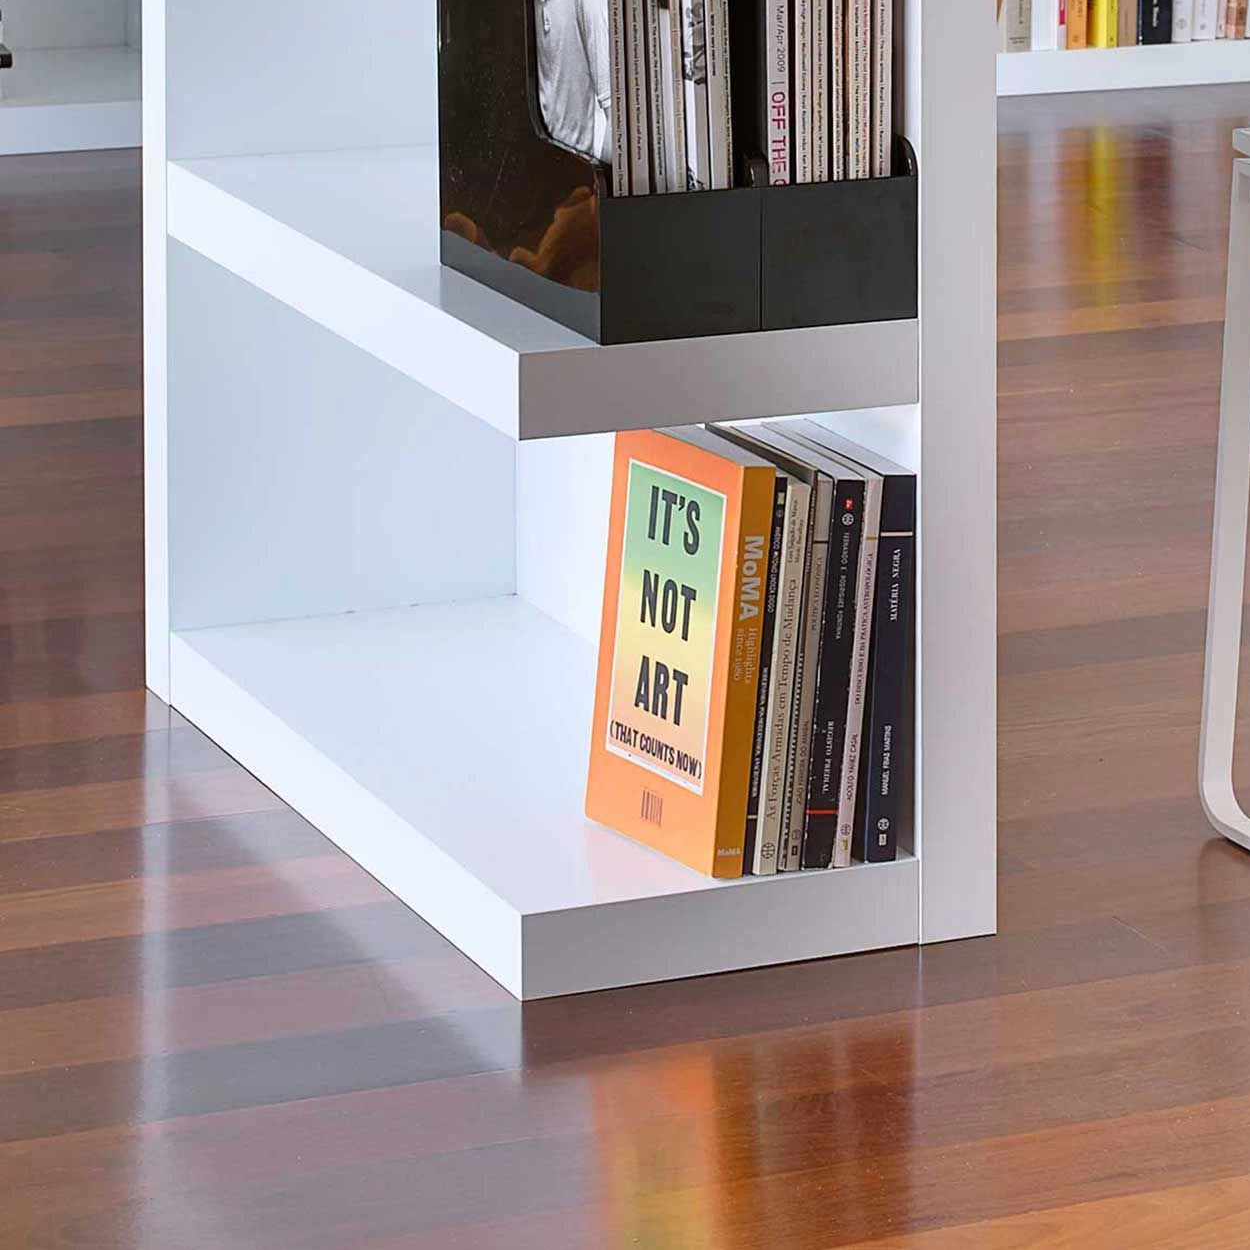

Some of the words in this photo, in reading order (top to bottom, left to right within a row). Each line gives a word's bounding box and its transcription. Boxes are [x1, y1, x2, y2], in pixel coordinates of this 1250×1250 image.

[776, 5, 786, 44] Mar/Apr
[776, 48, 785, 72] 2009
[771, 91, 785, 129] OFF
[771, 136, 786, 174] THE
[647, 484, 702, 557] IT'S
[739, 535, 765, 621] MoMA
[892, 548, 901, 578] NEGRA
[639, 568, 697, 642] NOT
[783, 579, 797, 629] Mudança
[888, 583, 899, 621] MATÉRIA
[782, 633, 792, 646] de
[778, 648, 792, 690] Tempo
[633, 654, 690, 727] ART
[777, 692, 785, 709] em
[609, 718, 638, 749] (THAT
[639, 731, 676, 766] COUNTS
[676, 750, 702, 780] NOW)
[772, 713, 785, 762] Armadas
[824, 720, 834, 756] REGISTO
[883, 725, 892, 751] MARTINS
[767, 765, 782, 802] Forças
[822, 758, 832, 794] PREDIAL
[881, 770, 890, 795] MANUEL
[766, 803, 776, 820] As
